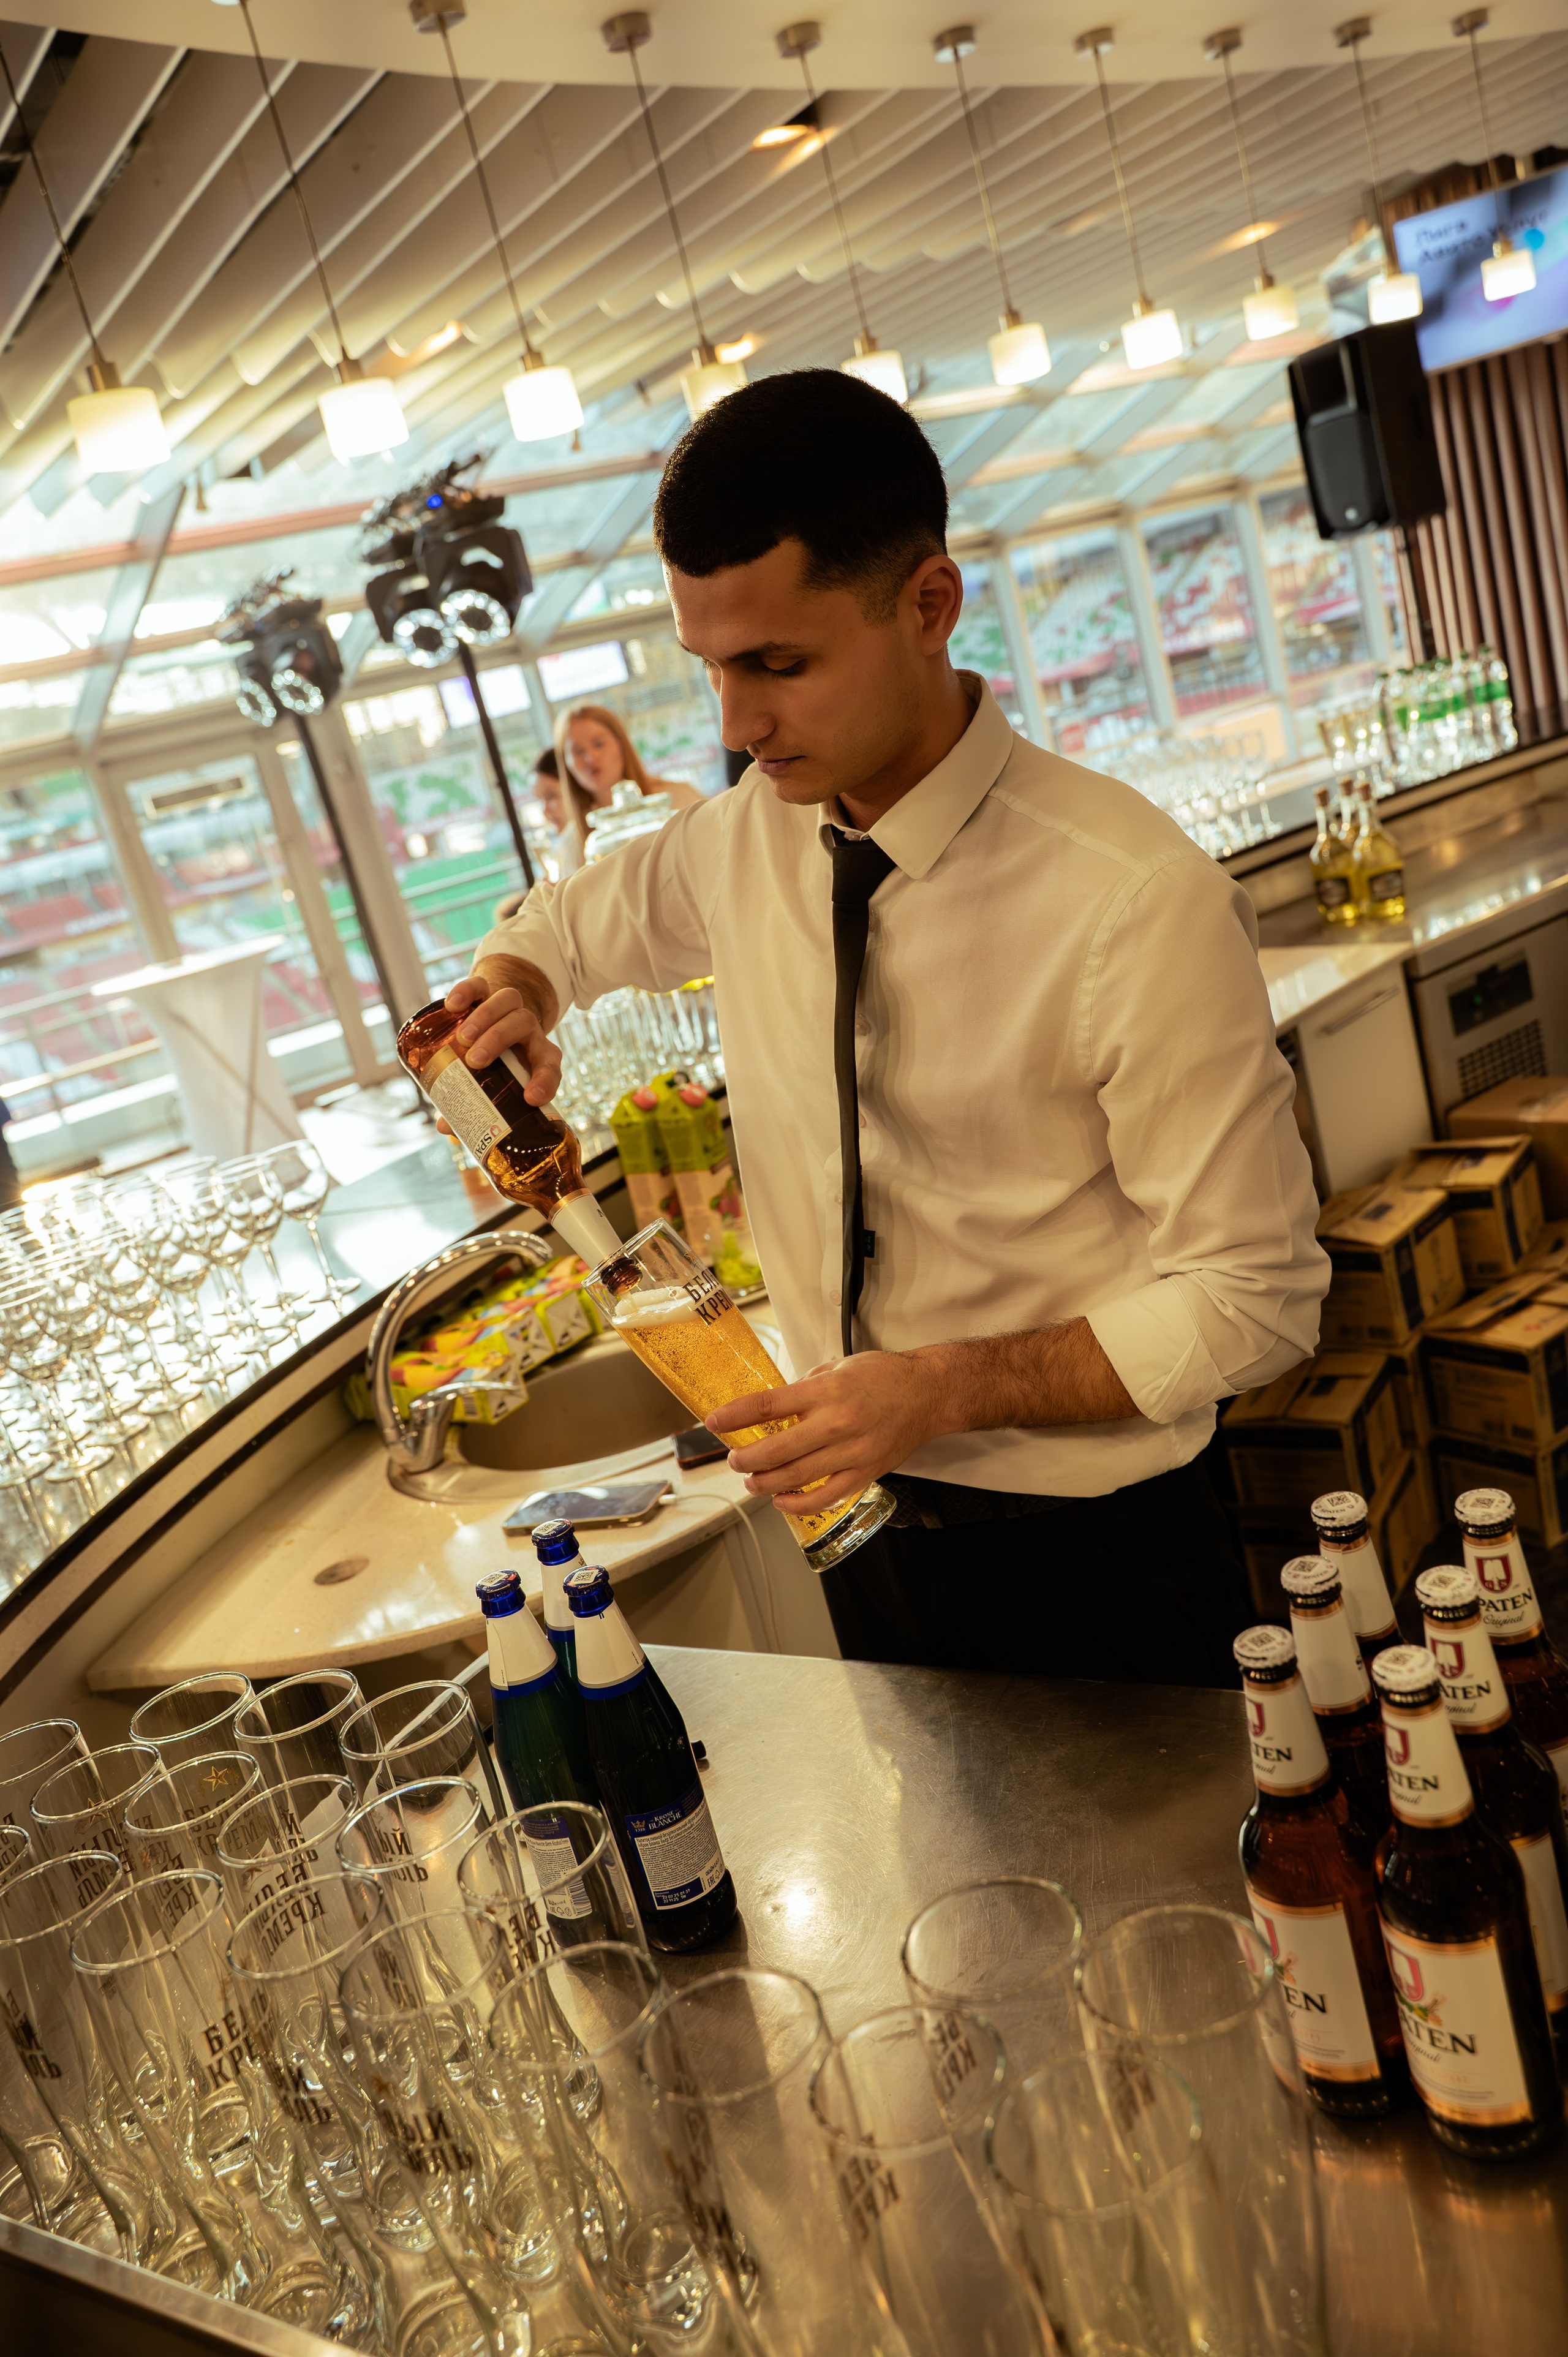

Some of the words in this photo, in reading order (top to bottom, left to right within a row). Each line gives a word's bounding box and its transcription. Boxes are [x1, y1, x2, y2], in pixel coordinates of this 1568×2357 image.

[1475, 1588, 1533, 1612] PATEN
[1483, 1610, 1524, 1629] Original
[1438, 1679, 1491, 1700] ATEN
[1253, 1742, 1292, 1762] TEN
[649, 1811, 682, 1830] BLANCHE
[654, 1810, 674, 1822] KRONE
[1400, 2007, 1477, 2054] ATEN
